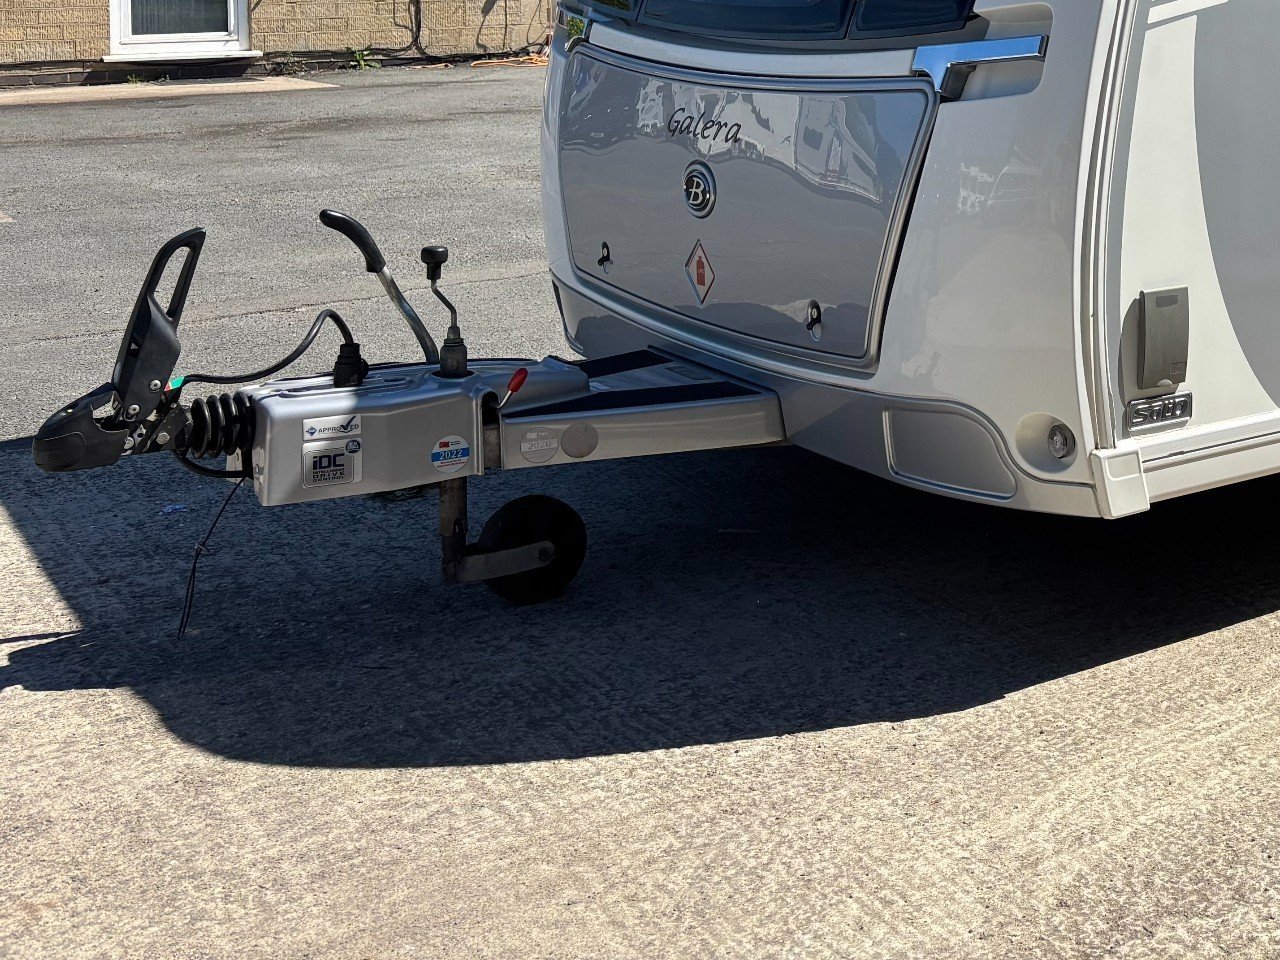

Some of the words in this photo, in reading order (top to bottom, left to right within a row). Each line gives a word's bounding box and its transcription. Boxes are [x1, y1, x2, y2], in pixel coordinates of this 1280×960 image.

[668, 107, 742, 143] Galera
[689, 177, 705, 205] B
[439, 449, 463, 460] 2022
